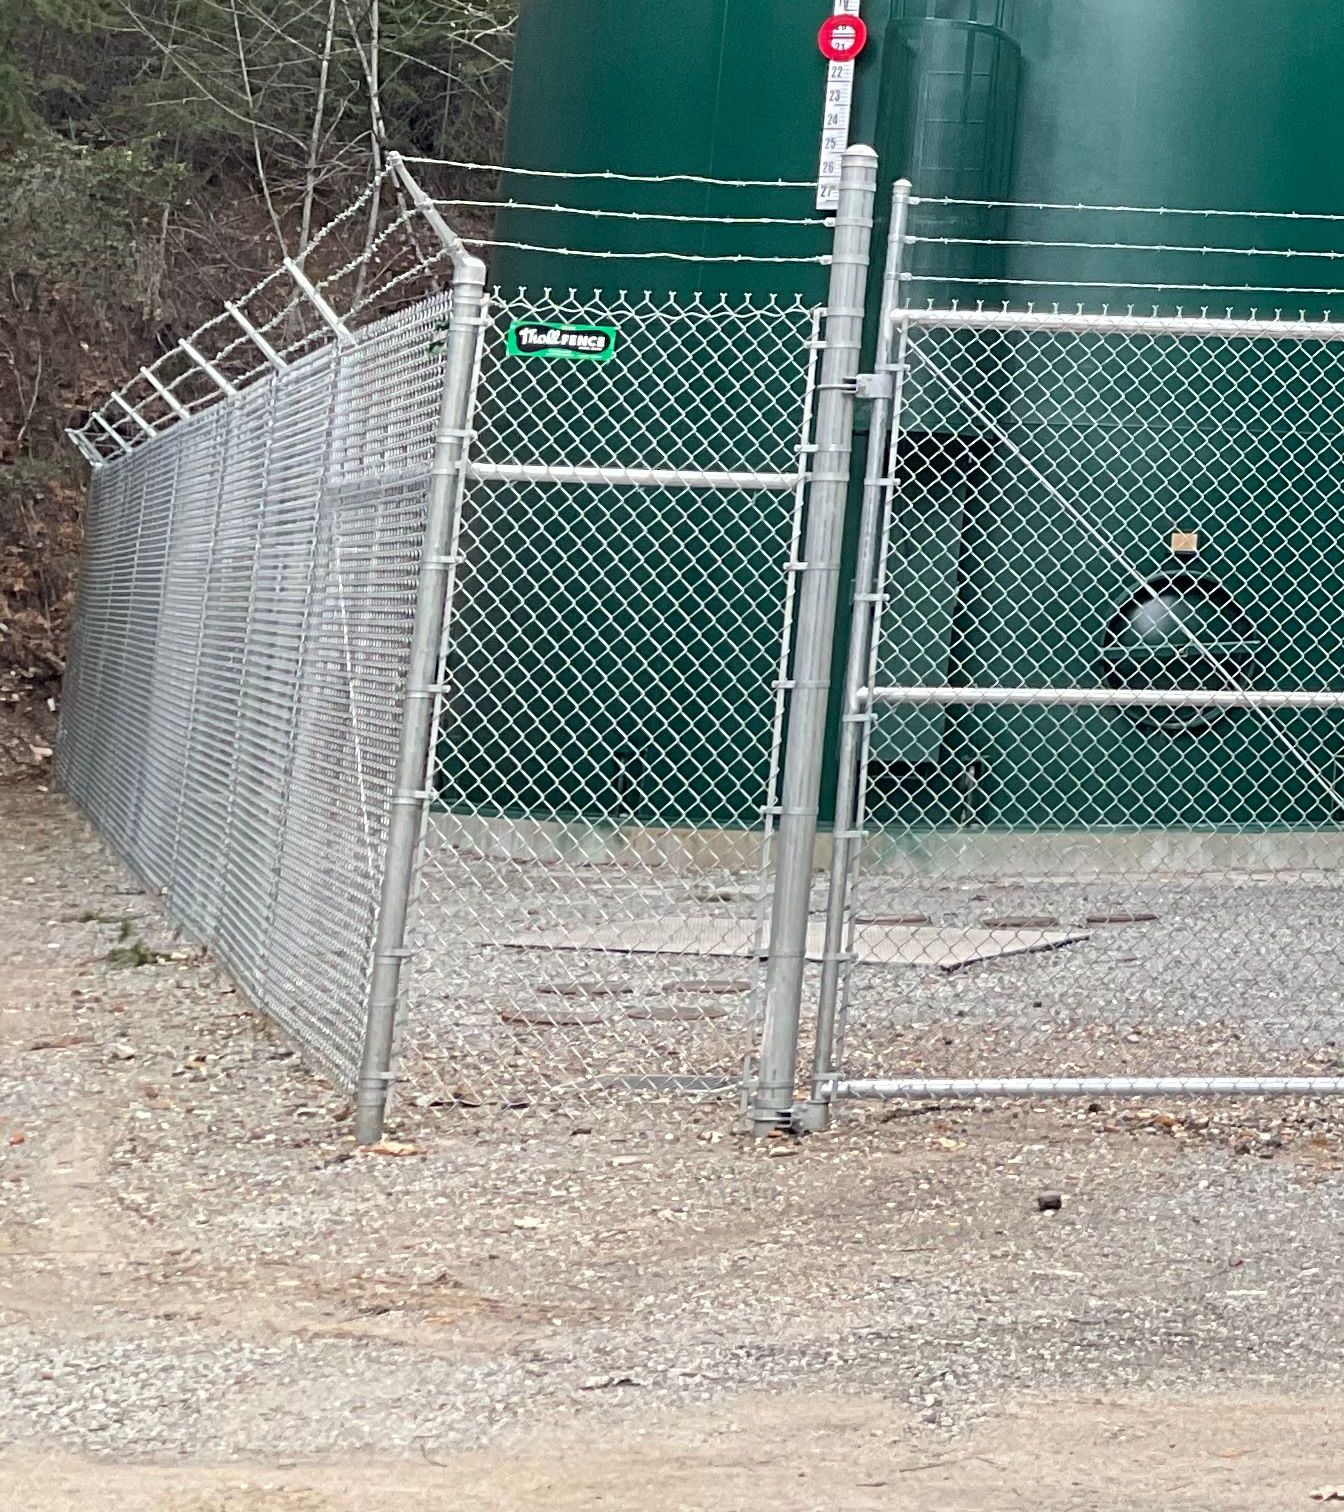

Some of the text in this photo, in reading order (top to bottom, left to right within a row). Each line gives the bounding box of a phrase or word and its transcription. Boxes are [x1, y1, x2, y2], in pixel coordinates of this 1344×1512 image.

[831, 66, 843, 78] 22
[829, 90, 840, 102] 23
[827, 113, 838, 125] 24
[825, 138, 836, 149] 25
[823, 161, 834, 173] 26
